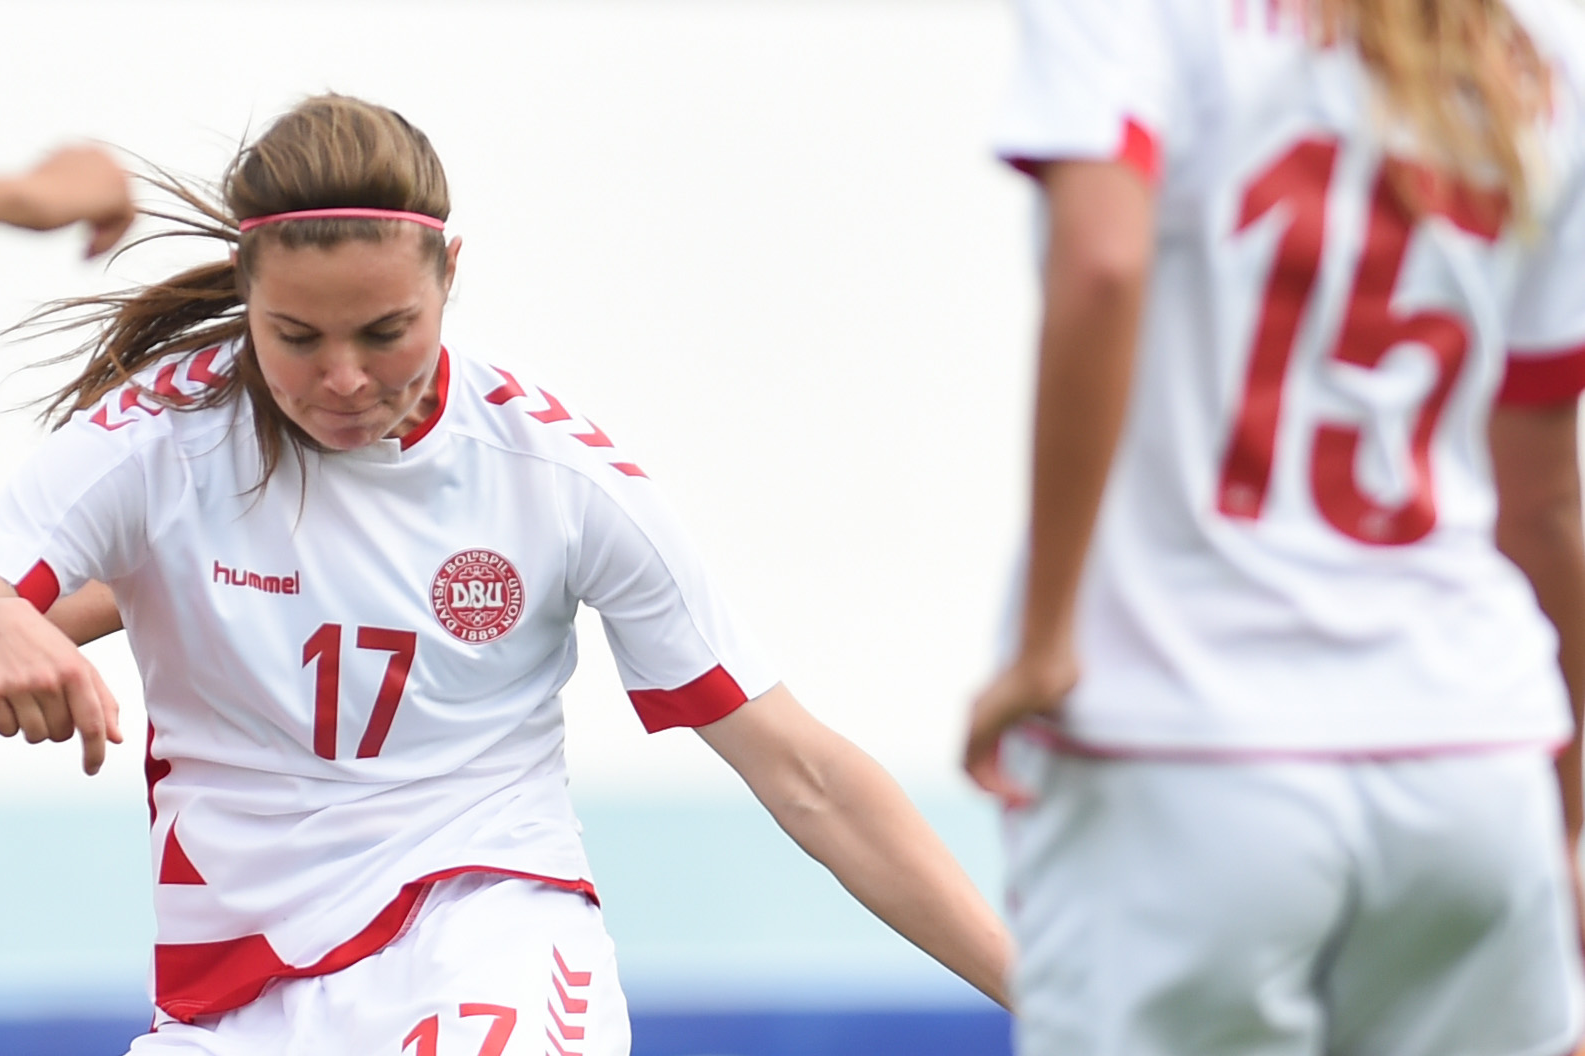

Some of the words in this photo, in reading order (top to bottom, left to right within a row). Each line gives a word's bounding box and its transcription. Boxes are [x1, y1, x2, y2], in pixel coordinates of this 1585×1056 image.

[1214, 133, 1511, 547] 15
[213, 559, 300, 595] hummel
[450, 579, 505, 609] DBU
[434, 576, 458, 631] DANSK
[499, 577, 522, 628] UNION
[460, 626, 498, 641] 1889
[301, 622, 417, 761] 17
